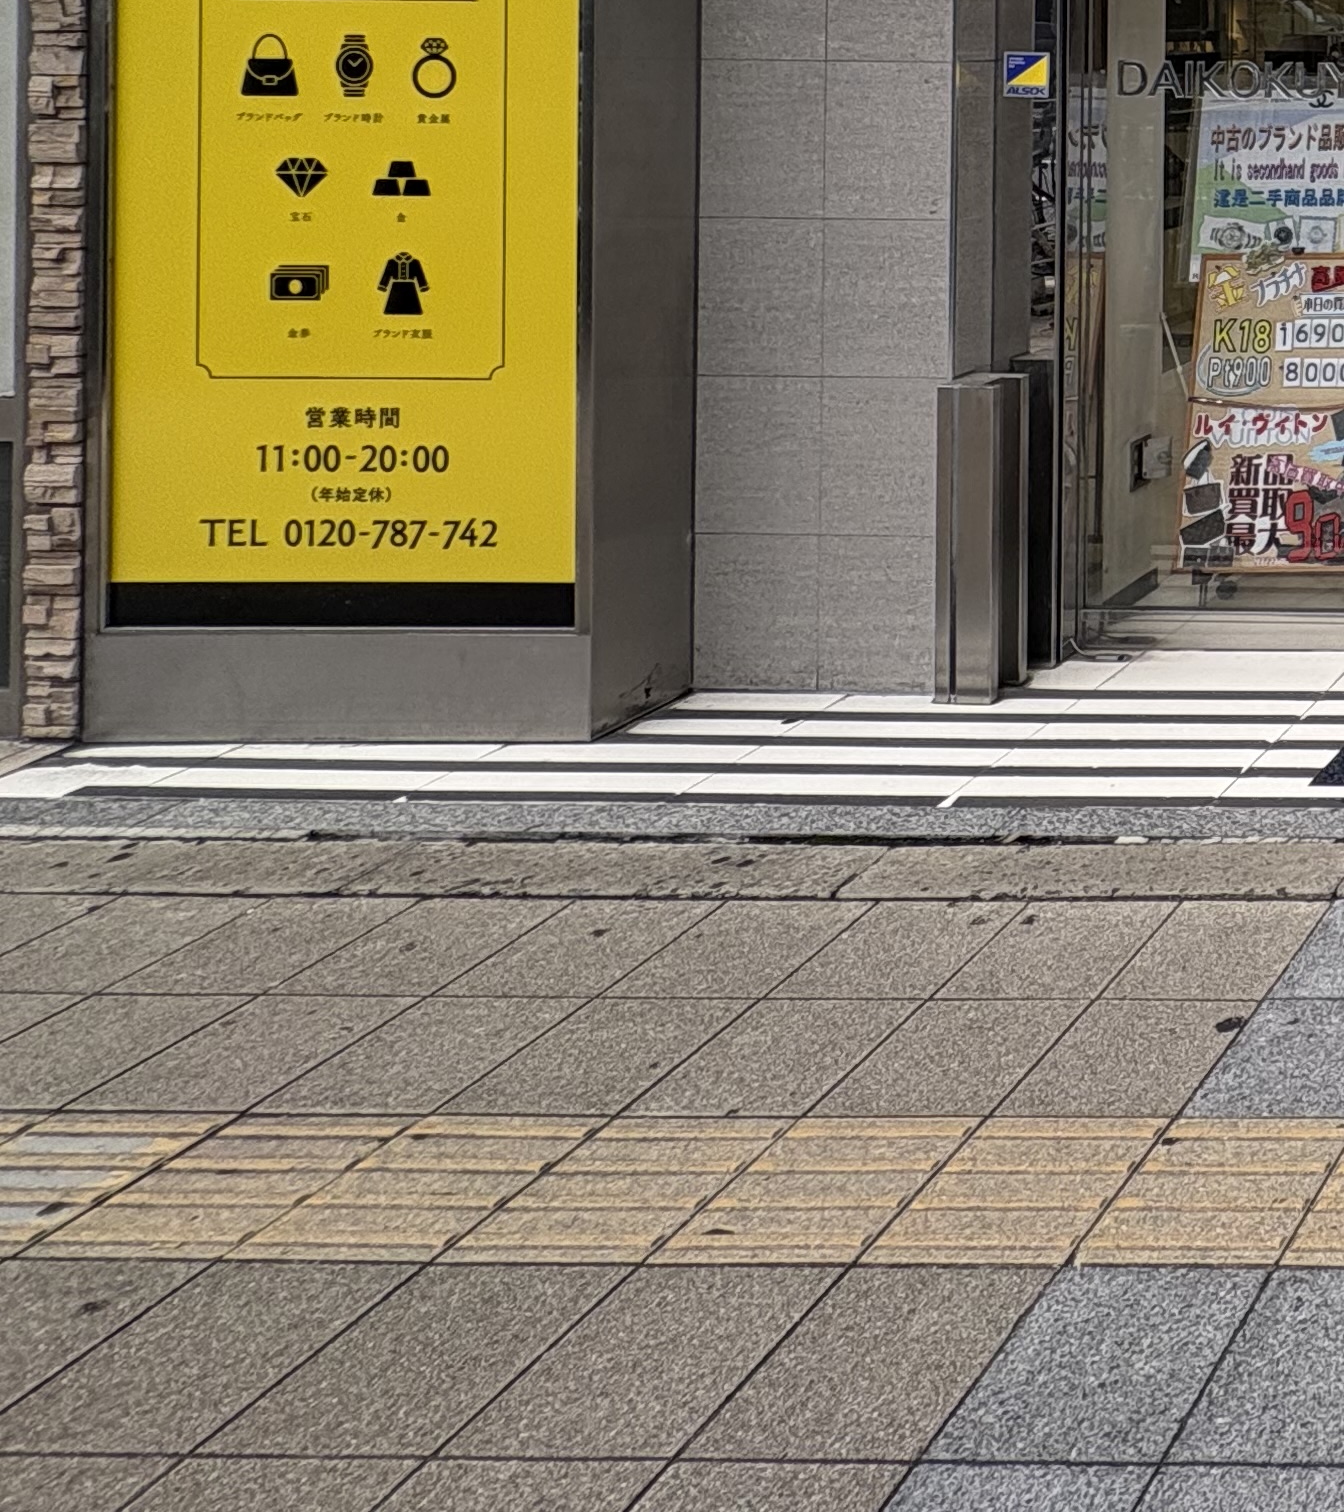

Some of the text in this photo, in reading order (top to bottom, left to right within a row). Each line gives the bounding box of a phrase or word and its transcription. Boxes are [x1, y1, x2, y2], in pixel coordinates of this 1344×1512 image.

[1006, 87, 1046, 96] ALSOK
[1212, 318, 1273, 354] K18
[1207, 356, 1273, 388] Pt900
[305, 406, 401, 429] 営業時間
[255, 444, 450, 473] 11:00-20:00
[199, 518, 499, 550] TEL 0120-787-742
